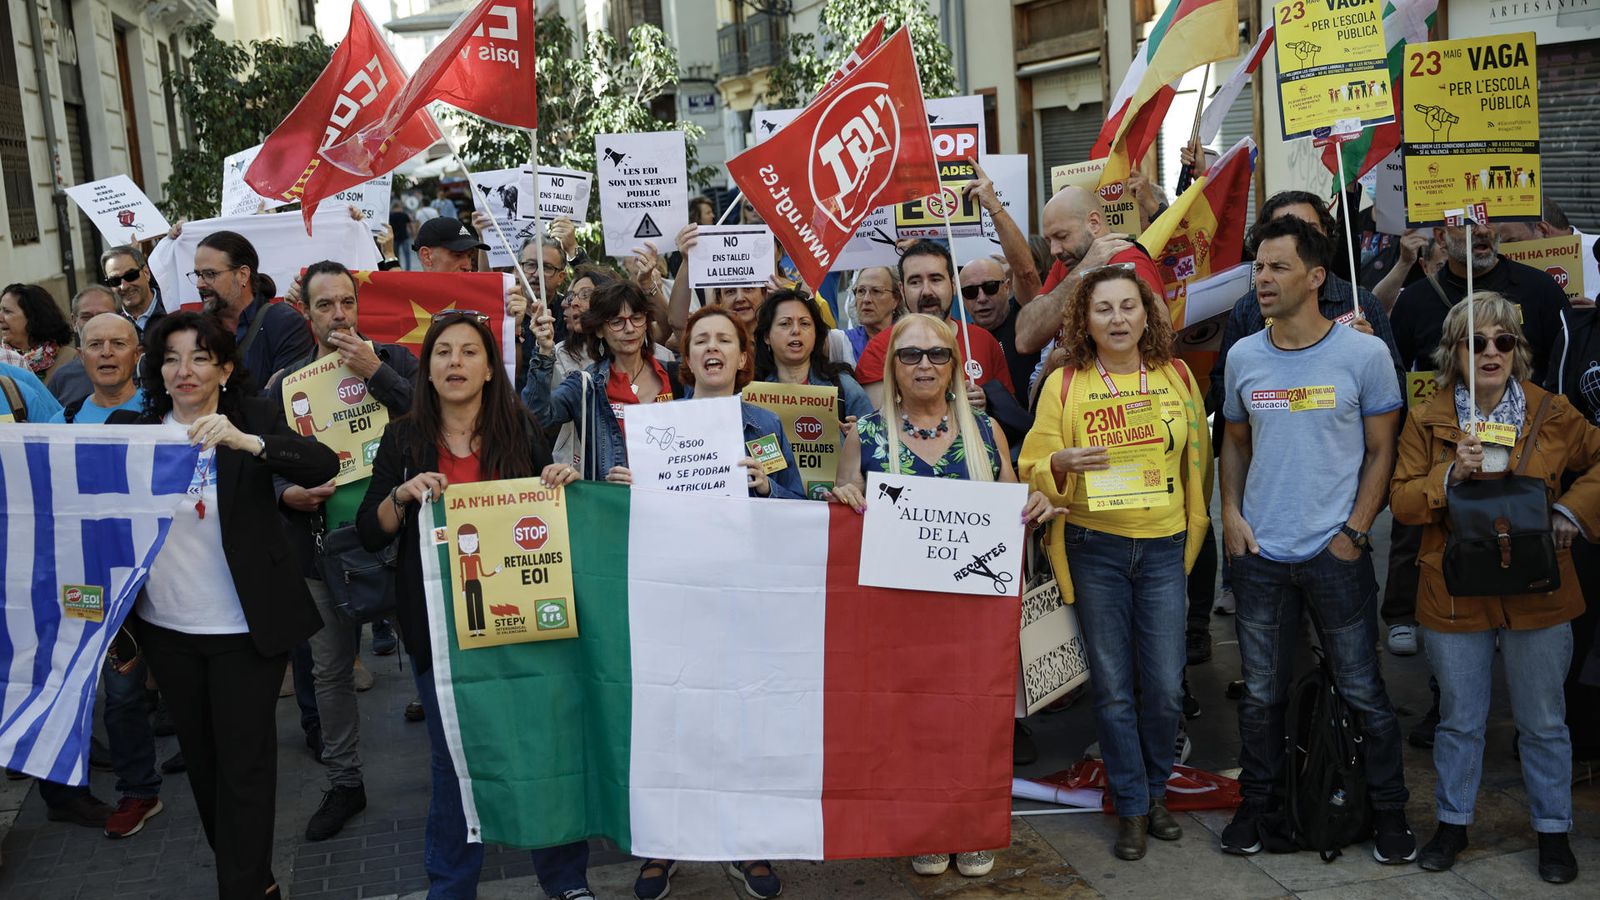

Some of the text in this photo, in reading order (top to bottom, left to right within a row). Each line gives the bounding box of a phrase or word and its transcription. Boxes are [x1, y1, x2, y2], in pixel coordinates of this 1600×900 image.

[1280, 1, 1306, 25] 23
[1312, 11, 1376, 32] PER L'ESCOLA
[1337, 24, 1378, 40] PÚBLICA
[1409, 42, 1529, 77] 23 MAIG VAGA
[1449, 76, 1530, 96] PER L'ESCOLA
[1481, 94, 1531, 112] PÚBLICA
[933, 133, 975, 156] OP
[642, 167, 658, 175] EOI
[1087, 164, 1101, 173] HA
[551, 177, 564, 188] NO
[608, 179, 627, 187] SON
[644, 177, 677, 186] SERVEI
[553, 191, 573, 201] TALLEU
[626, 189, 661, 198] PUBLIC
[1100, 183, 1123, 196] STOP
[346, 192, 364, 202] SOM
[544, 204, 574, 214] LLENGUA
[617, 200, 671, 209] NECESSARI!
[1102, 202, 1134, 213] ALLADES
[873, 218, 888, 226] QUE
[724, 236, 738, 247] NO
[726, 253, 750, 262] TALLEU
[1528, 250, 1543, 259] HA
[1545, 243, 1579, 259] PROU!
[707, 266, 755, 277] LA LLENGUA
[285, 378, 298, 386] JA
[298, 367, 319, 380] N'HI
[320, 362, 337, 373] HA
[338, 383, 365, 398] STOP
[1100, 391, 1113, 400] UNA
[1120, 390, 1136, 398] COLA
[1252, 392, 1275, 400] CCOO
[1288, 388, 1308, 402] 23M
[745, 392, 835, 412] JA N'HI HA PROU!
[1252, 400, 1288, 409] educació
[332, 402, 381, 422] RETALLADES
[348, 416, 372, 434] EOI
[1083, 404, 1126, 434] 23M
[796, 423, 822, 433] STOP
[1465, 422, 1486, 433] 2M
[1100, 431, 1122, 447] FAIG
[1124, 424, 1155, 442] VAGA!
[679, 439, 704, 449] 8500
[763, 443, 778, 454] EOI
[791, 443, 834, 453] ETALLADES
[667, 452, 718, 464] PERSONAS
[799, 455, 822, 468] EOI
[658, 466, 730, 480] NO SE PODRAN
[449, 488, 561, 510] JA N'HI HA PROU!
[1110, 497, 1124, 506] VAGA
[899, 507, 991, 527] ALUMNOS
[515, 526, 547, 541] STOP
[918, 526, 970, 544] DE LA
[927, 545, 958, 561] EOI
[504, 552, 563, 568] RETALLADES
[953, 542, 1007, 582] RECORTES
[521, 568, 549, 586] EOI
[83, 594, 100, 604] EOI
[494, 617, 526, 628] STEPV
